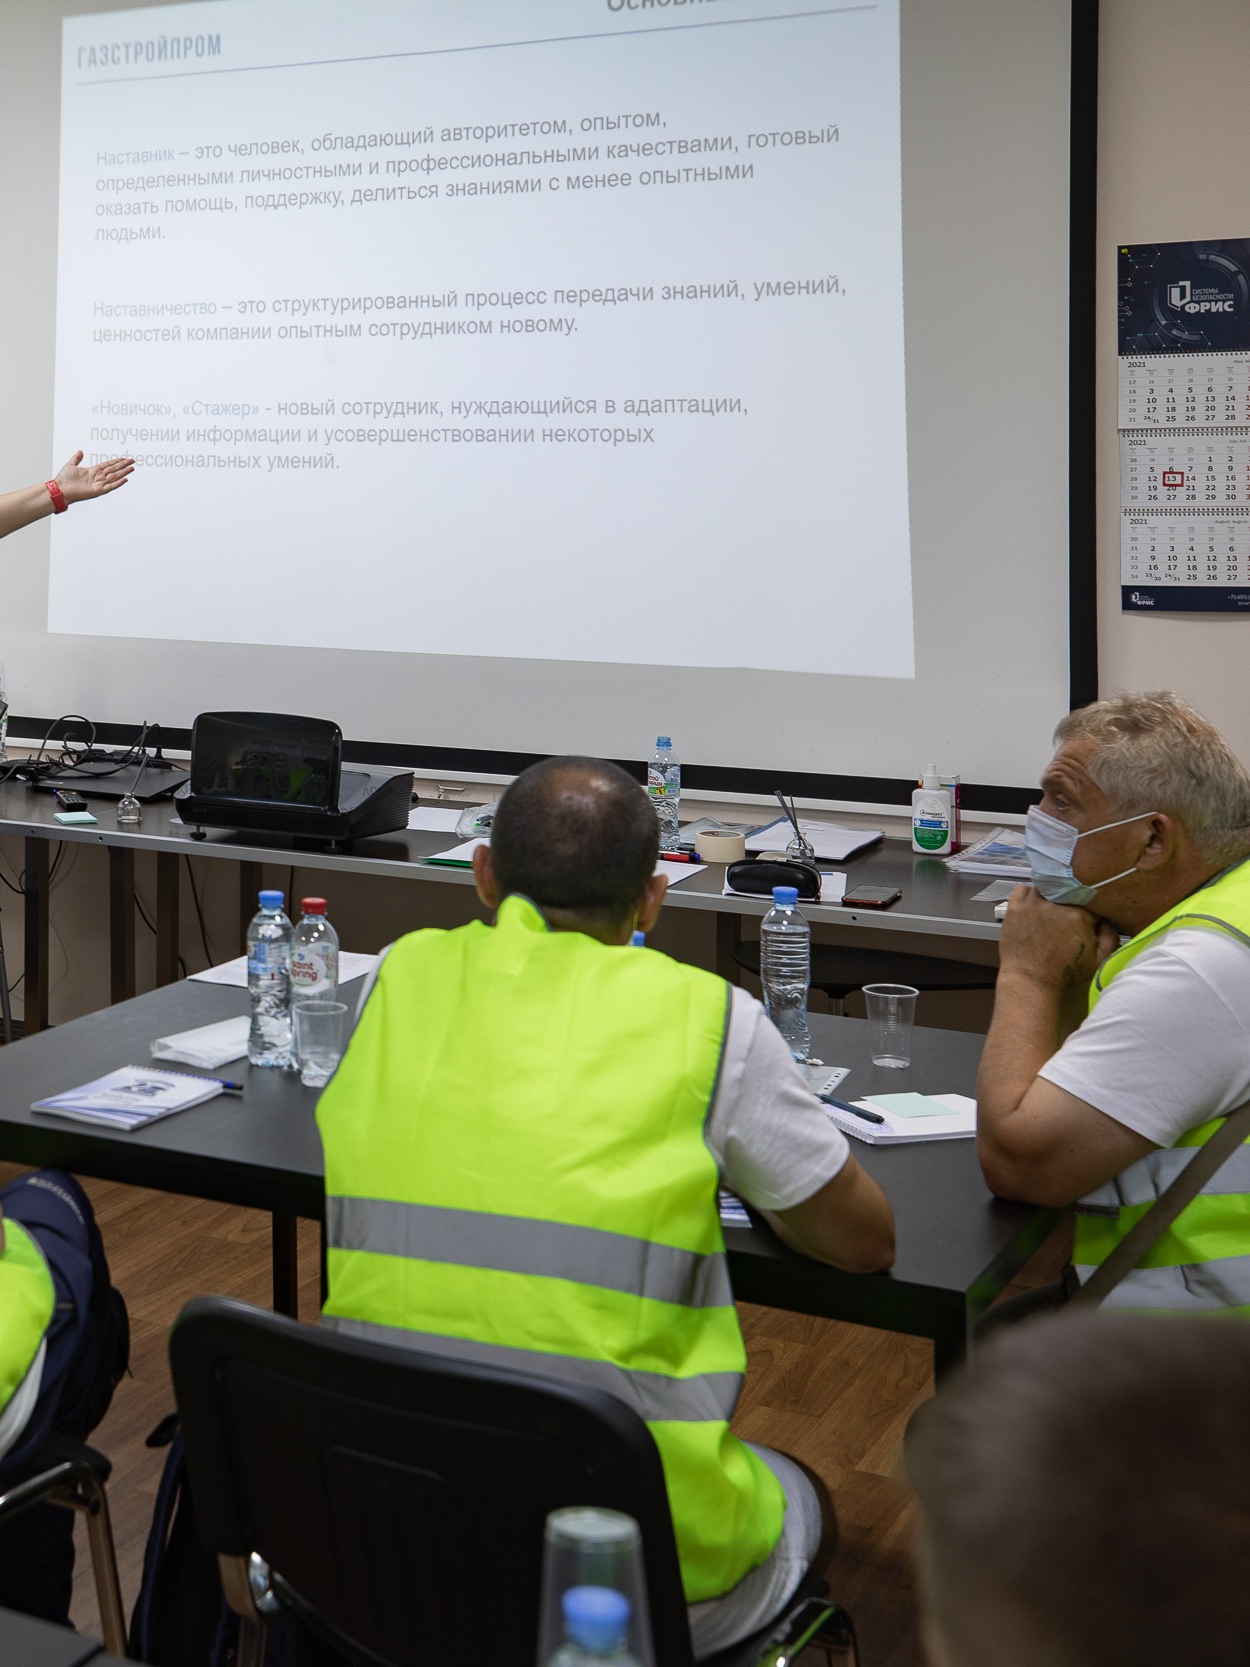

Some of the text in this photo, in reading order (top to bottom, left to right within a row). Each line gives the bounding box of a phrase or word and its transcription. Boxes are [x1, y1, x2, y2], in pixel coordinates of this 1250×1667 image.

[77, 33, 222, 69] ГАЗСТРОЙПРОМ
[96, 148, 175, 167] Наставник
[194, 145, 223, 160] это
[227, 139, 305, 157] человек,
[310, 125, 434, 152] обладающий
[440, 119, 573, 144] авторитетом,
[580, 111, 667, 132] опытом,
[95, 123, 840, 195] определенными личностными и профессиональными качествами, готовый
[95, 163, 754, 217] оказать помощь, поддержку, делиться знаниями с менее опытными
[94, 225, 166, 244] людьми.
[93, 301, 218, 317] Наставничество
[237, 299, 267, 314] это
[272, 293, 458, 317] структурированный
[464, 290, 547, 312] процесс
[554, 286, 654, 308] передачи
[661, 279, 745, 301] знаний,
[752, 274, 846, 302] умений,
[1184, 300, 1234, 313] ФРИС
[1192, 293, 1234, 301] БЕЗОПАСНОСТИ
[92, 317, 578, 345] ценностей компании опытным сотрудником новому.
[90, 399, 177, 418] «Новичок»,
[182, 399, 260, 420] «Стажер»
[277, 398, 335, 416] новый
[341, 400, 444, 420] сотрудник,
[451, 396, 597, 419] нуждающийся
[604, 399, 617, 414] в
[623, 398, 748, 417] адаптации,
[90, 424, 655, 447] получении информации и усовершенствовании некоторых
[267, 452, 340, 473] умений.
